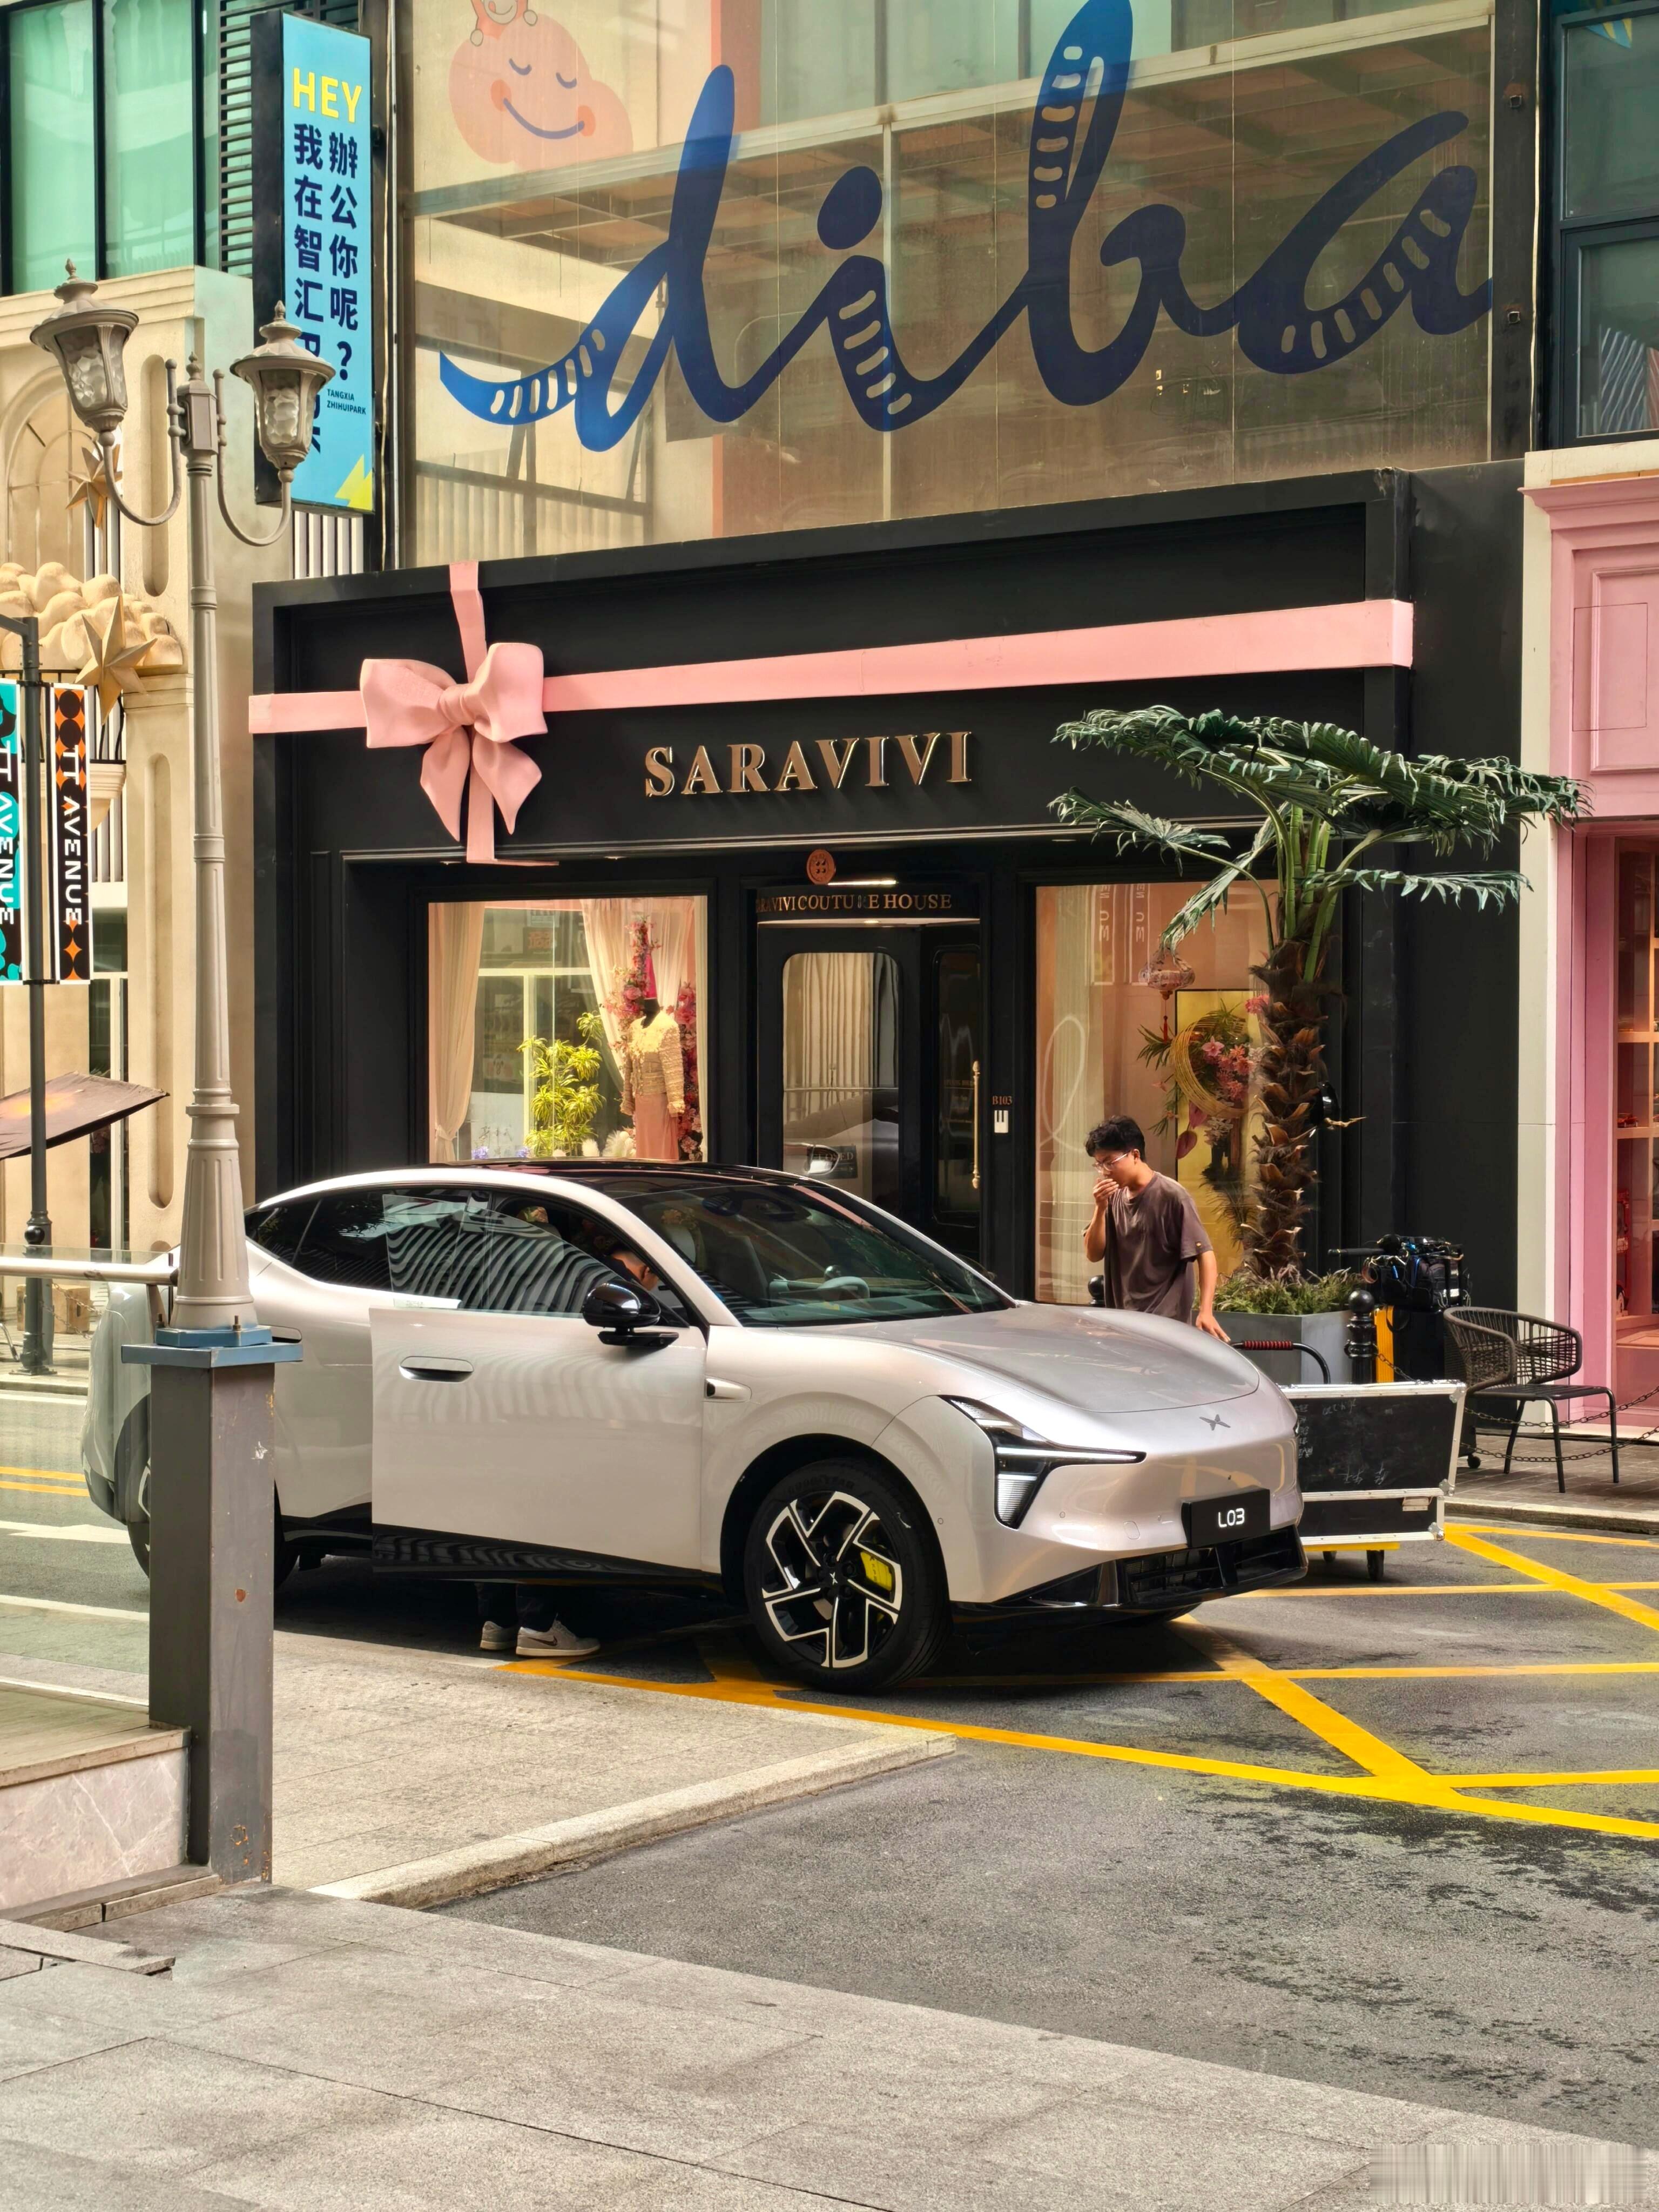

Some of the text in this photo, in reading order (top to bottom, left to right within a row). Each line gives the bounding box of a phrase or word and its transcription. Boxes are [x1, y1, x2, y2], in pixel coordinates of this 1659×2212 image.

[292, 67, 363, 124] HEY
[327, 388, 355, 402] TANGXIA
[327, 400, 367, 415] ZHIHUIPARK
[645, 731, 972, 798] SARAVIVI
[0, 792, 14, 925] AVENUE
[63, 795, 82, 925] AVENUE
[884, 894, 952, 911] HOUSE
[992, 1095, 1013, 1105] B103
